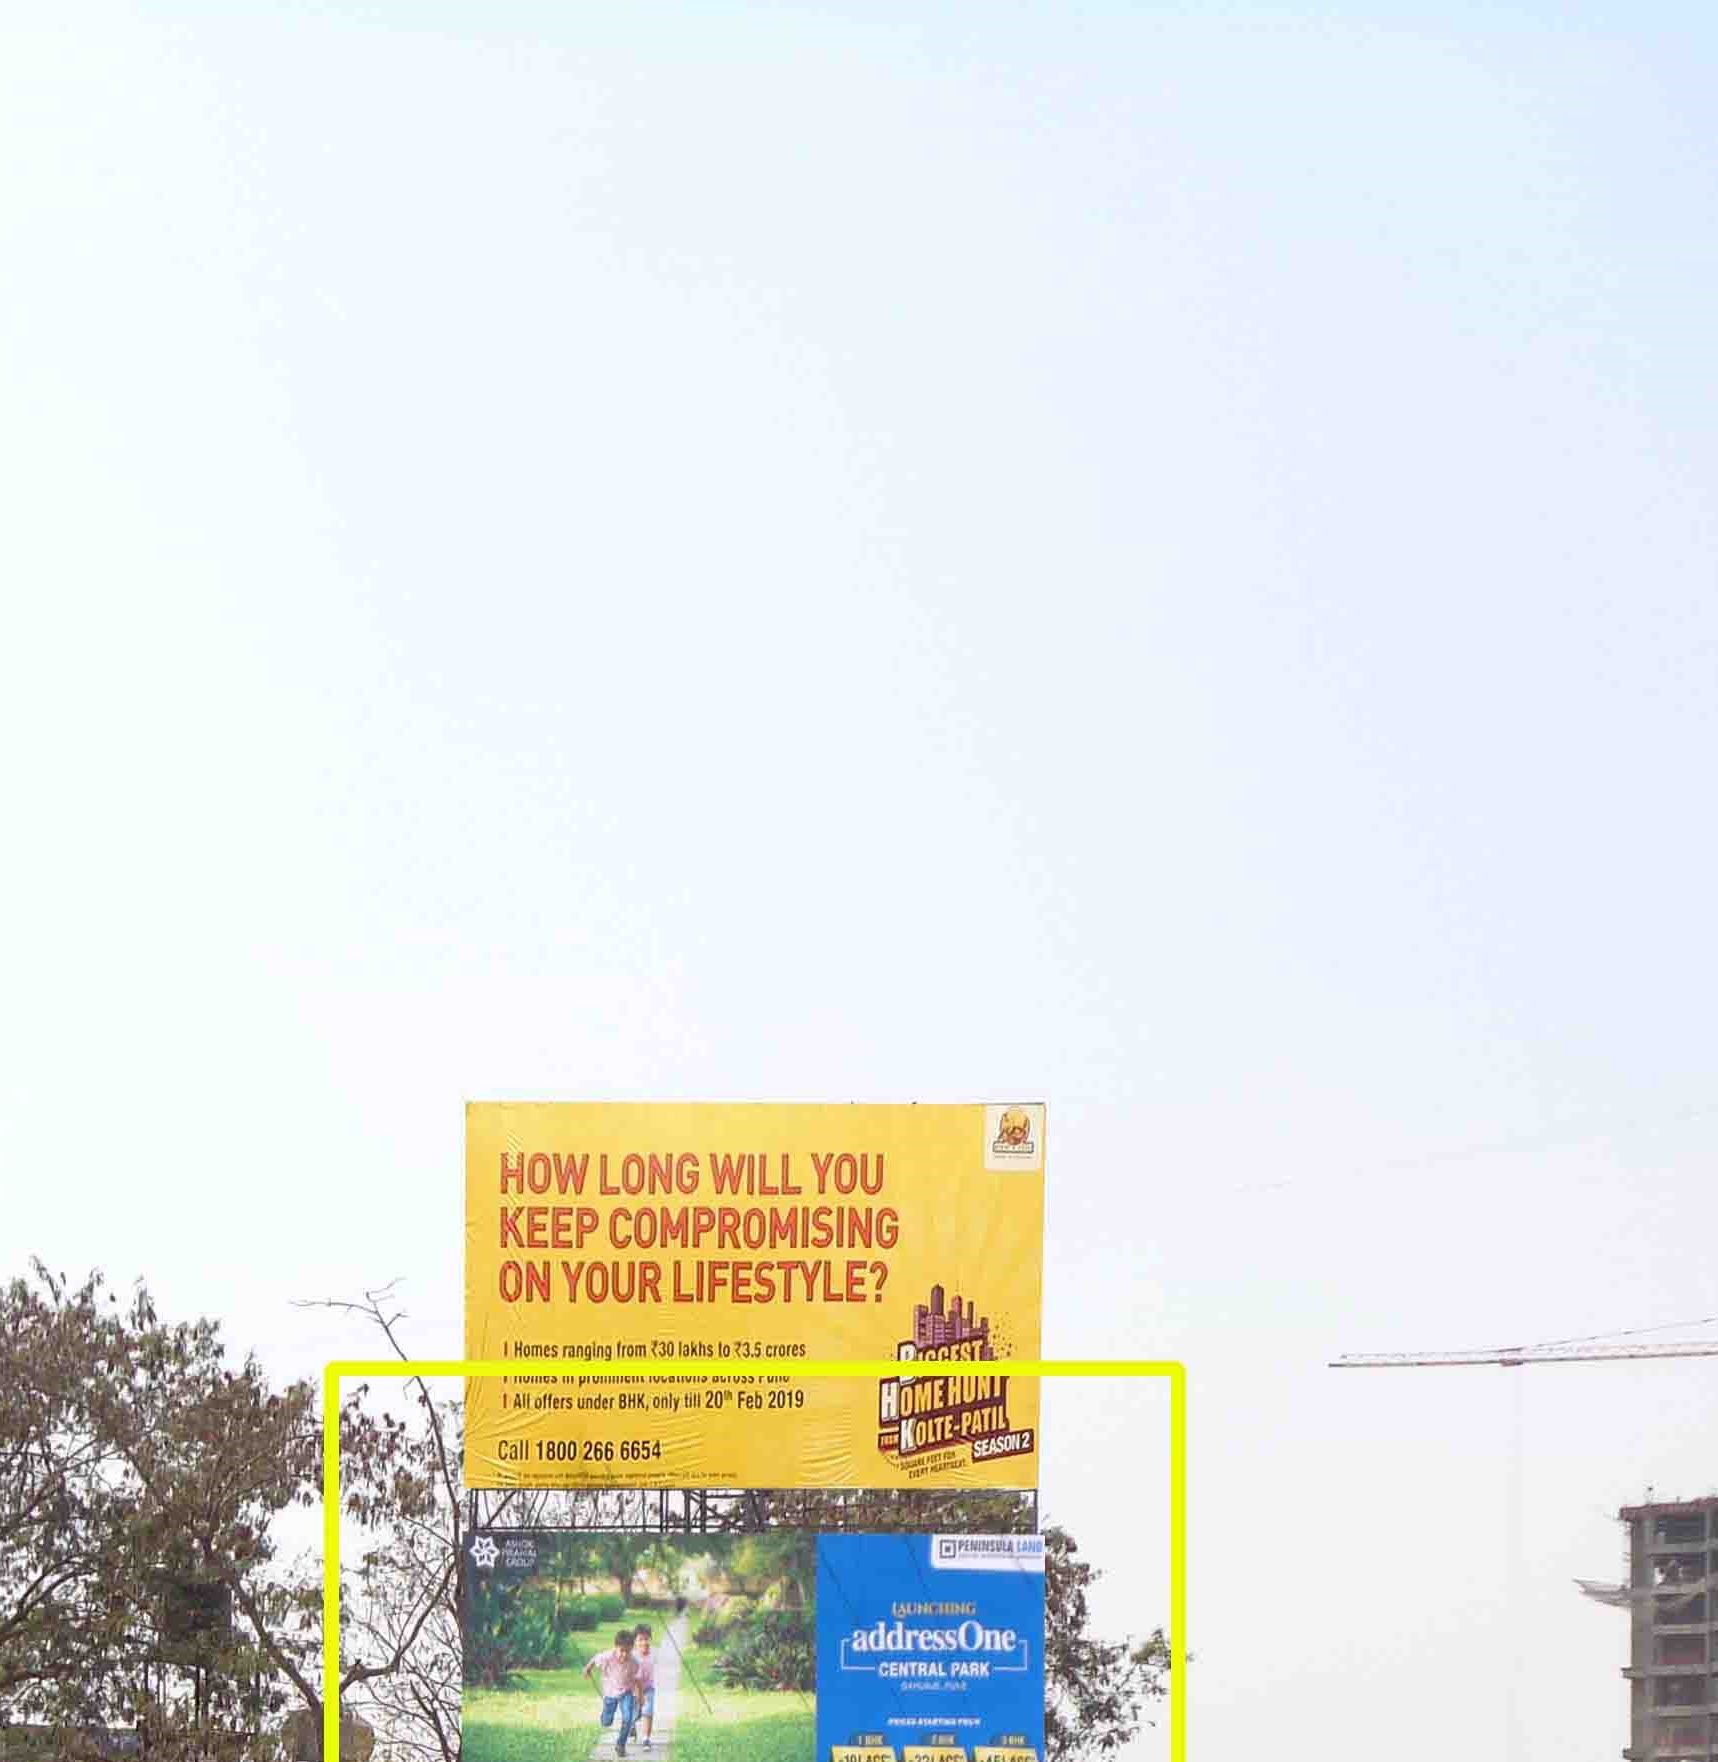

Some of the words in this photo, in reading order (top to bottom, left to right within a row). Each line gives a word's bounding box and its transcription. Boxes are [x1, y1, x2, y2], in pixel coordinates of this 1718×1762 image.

[500, 1152, 589, 1195] HOW
[600, 1152, 699, 1195] LONG
[709, 1152, 802, 1196] WILL
[811, 1152, 883, 1195] YOU
[500, 1206, 599, 1249] KEEP
[609, 1206, 899, 1249] COMPROMISING
[499, 1260, 551, 1303] ON
[561, 1260, 662, 1303] YOUR
[673, 1260, 889, 1303] LIFESTYLE?
[514, 1340, 558, 1358] Homes
[562, 1341, 613, 1361] ranging
[616, 1340, 647, 1358] from
[678, 1341, 714, 1357] lakhs
[718, 1342, 731, 1357] to
[765, 1343, 807, 1358] crores
[514, 1393, 530, 1409] All
[534, 1393, 573, 1409] offers
[577, 1393, 615, 1409] under
[619, 1393, 650, 1411] BHK,
[652, 1392, 680, 1412] only
[684, 1392, 701, 1409] till
[705, 1390, 733, 1409] 20th
[737, 1391, 763, 1409] Feb
[768, 1390, 804, 1409] 2019
[881, 1379, 945, 1422] HOME
[947, 1376, 1002, 1406] HUNT
[899, 1405, 1007, 1453] KOLTE-PATIL
[498, 1440, 530, 1460] Call
[536, 1440, 577, 1461] 1800
[583, 1440, 614, 1461] 266
[620, 1440, 661, 1461] 6654
[973, 1434, 1021, 1458] SEASON
[1021, 1431, 1031, 1448] 2
[958, 1540, 1014, 1552] PENINSULA
[852, 1620, 1017, 1652] addressOne
[878, 1661, 947, 1678] CENTRAL
[951, 1661, 991, 1678] PARK
